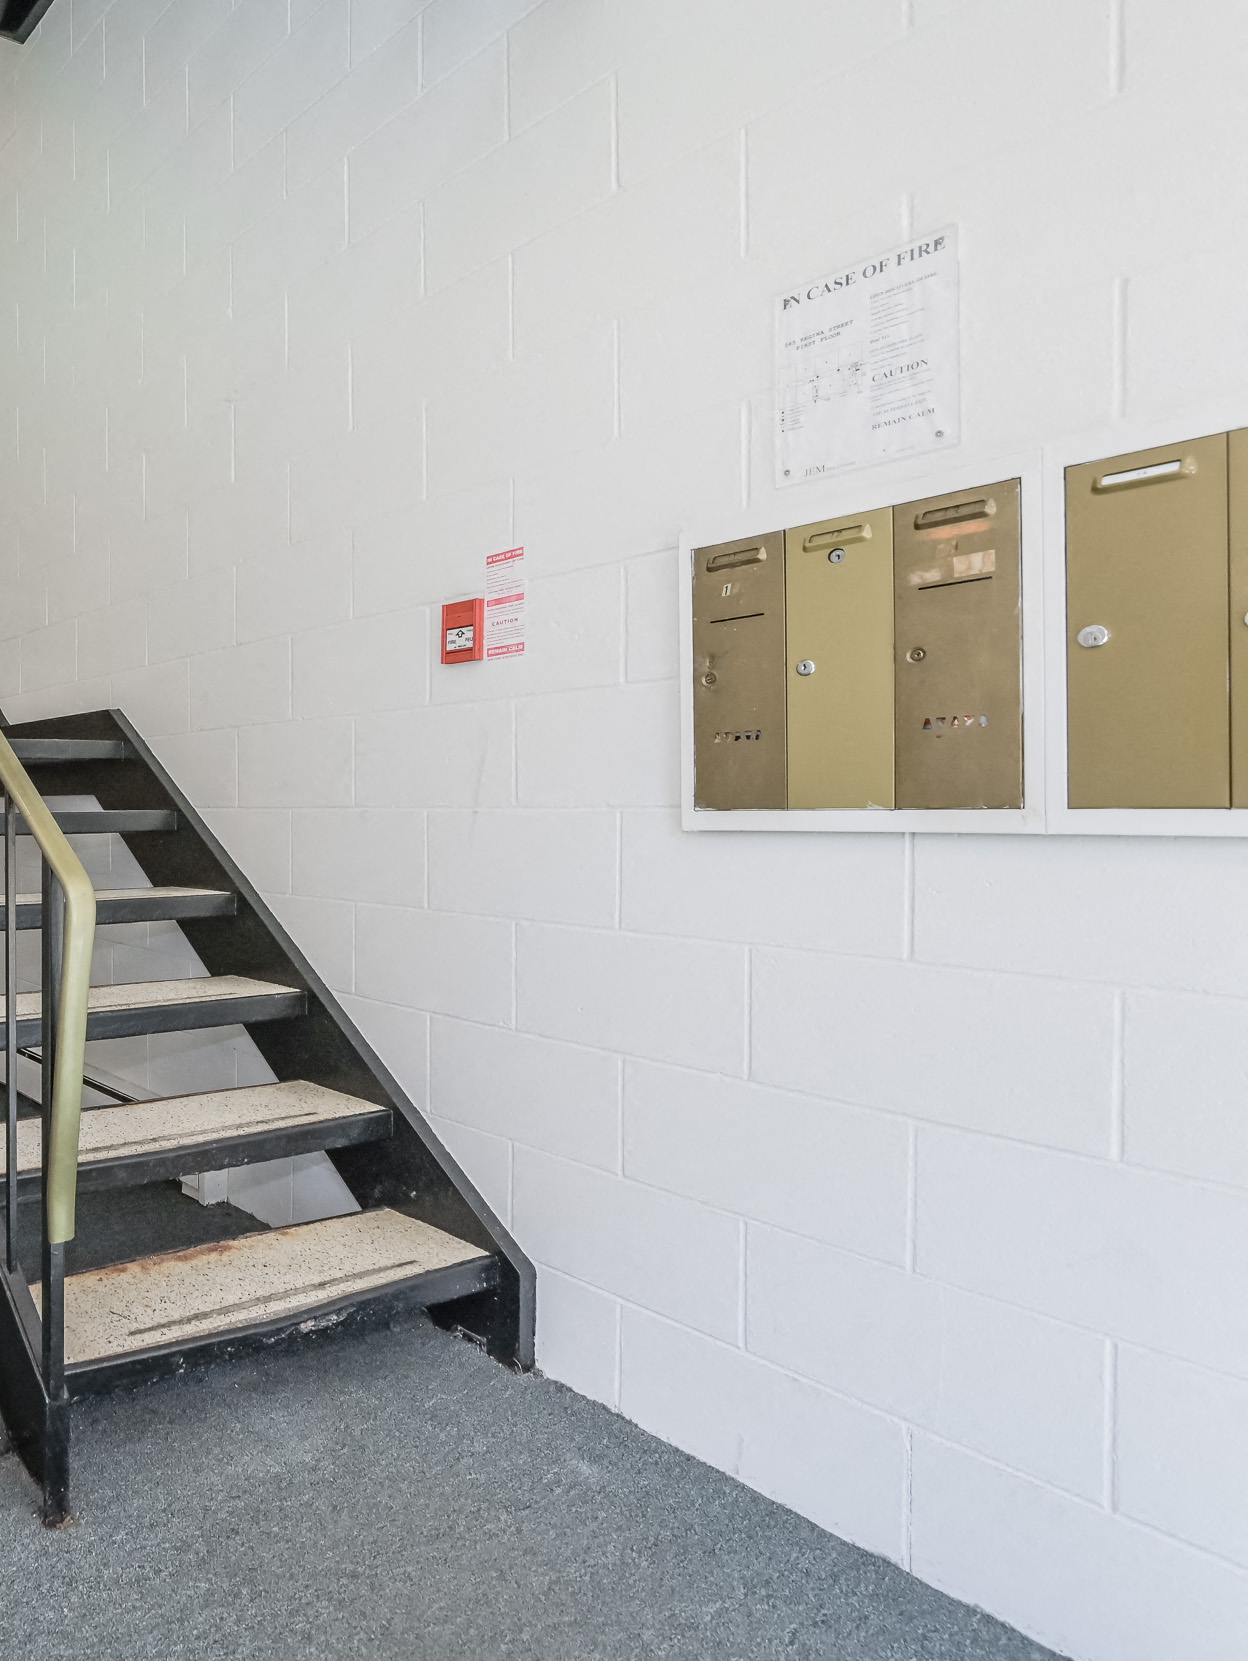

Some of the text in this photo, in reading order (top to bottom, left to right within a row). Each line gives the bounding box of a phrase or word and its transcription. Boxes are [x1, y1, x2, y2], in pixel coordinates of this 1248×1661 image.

[806, 271, 857, 301] CASE
[862, 258, 890, 279] OF
[897, 237, 946, 267] FIRE
[796, 331, 841, 351] FIRST FLOOR
[800, 330, 825, 342] REGINA
[828, 319, 854, 333] STREET
[871, 359, 929, 383] CAUTION
[871, 407, 935, 431] REMAIN CALM
[803, 465, 826, 478] JEM
[491, 617, 519, 627] CAUTION
